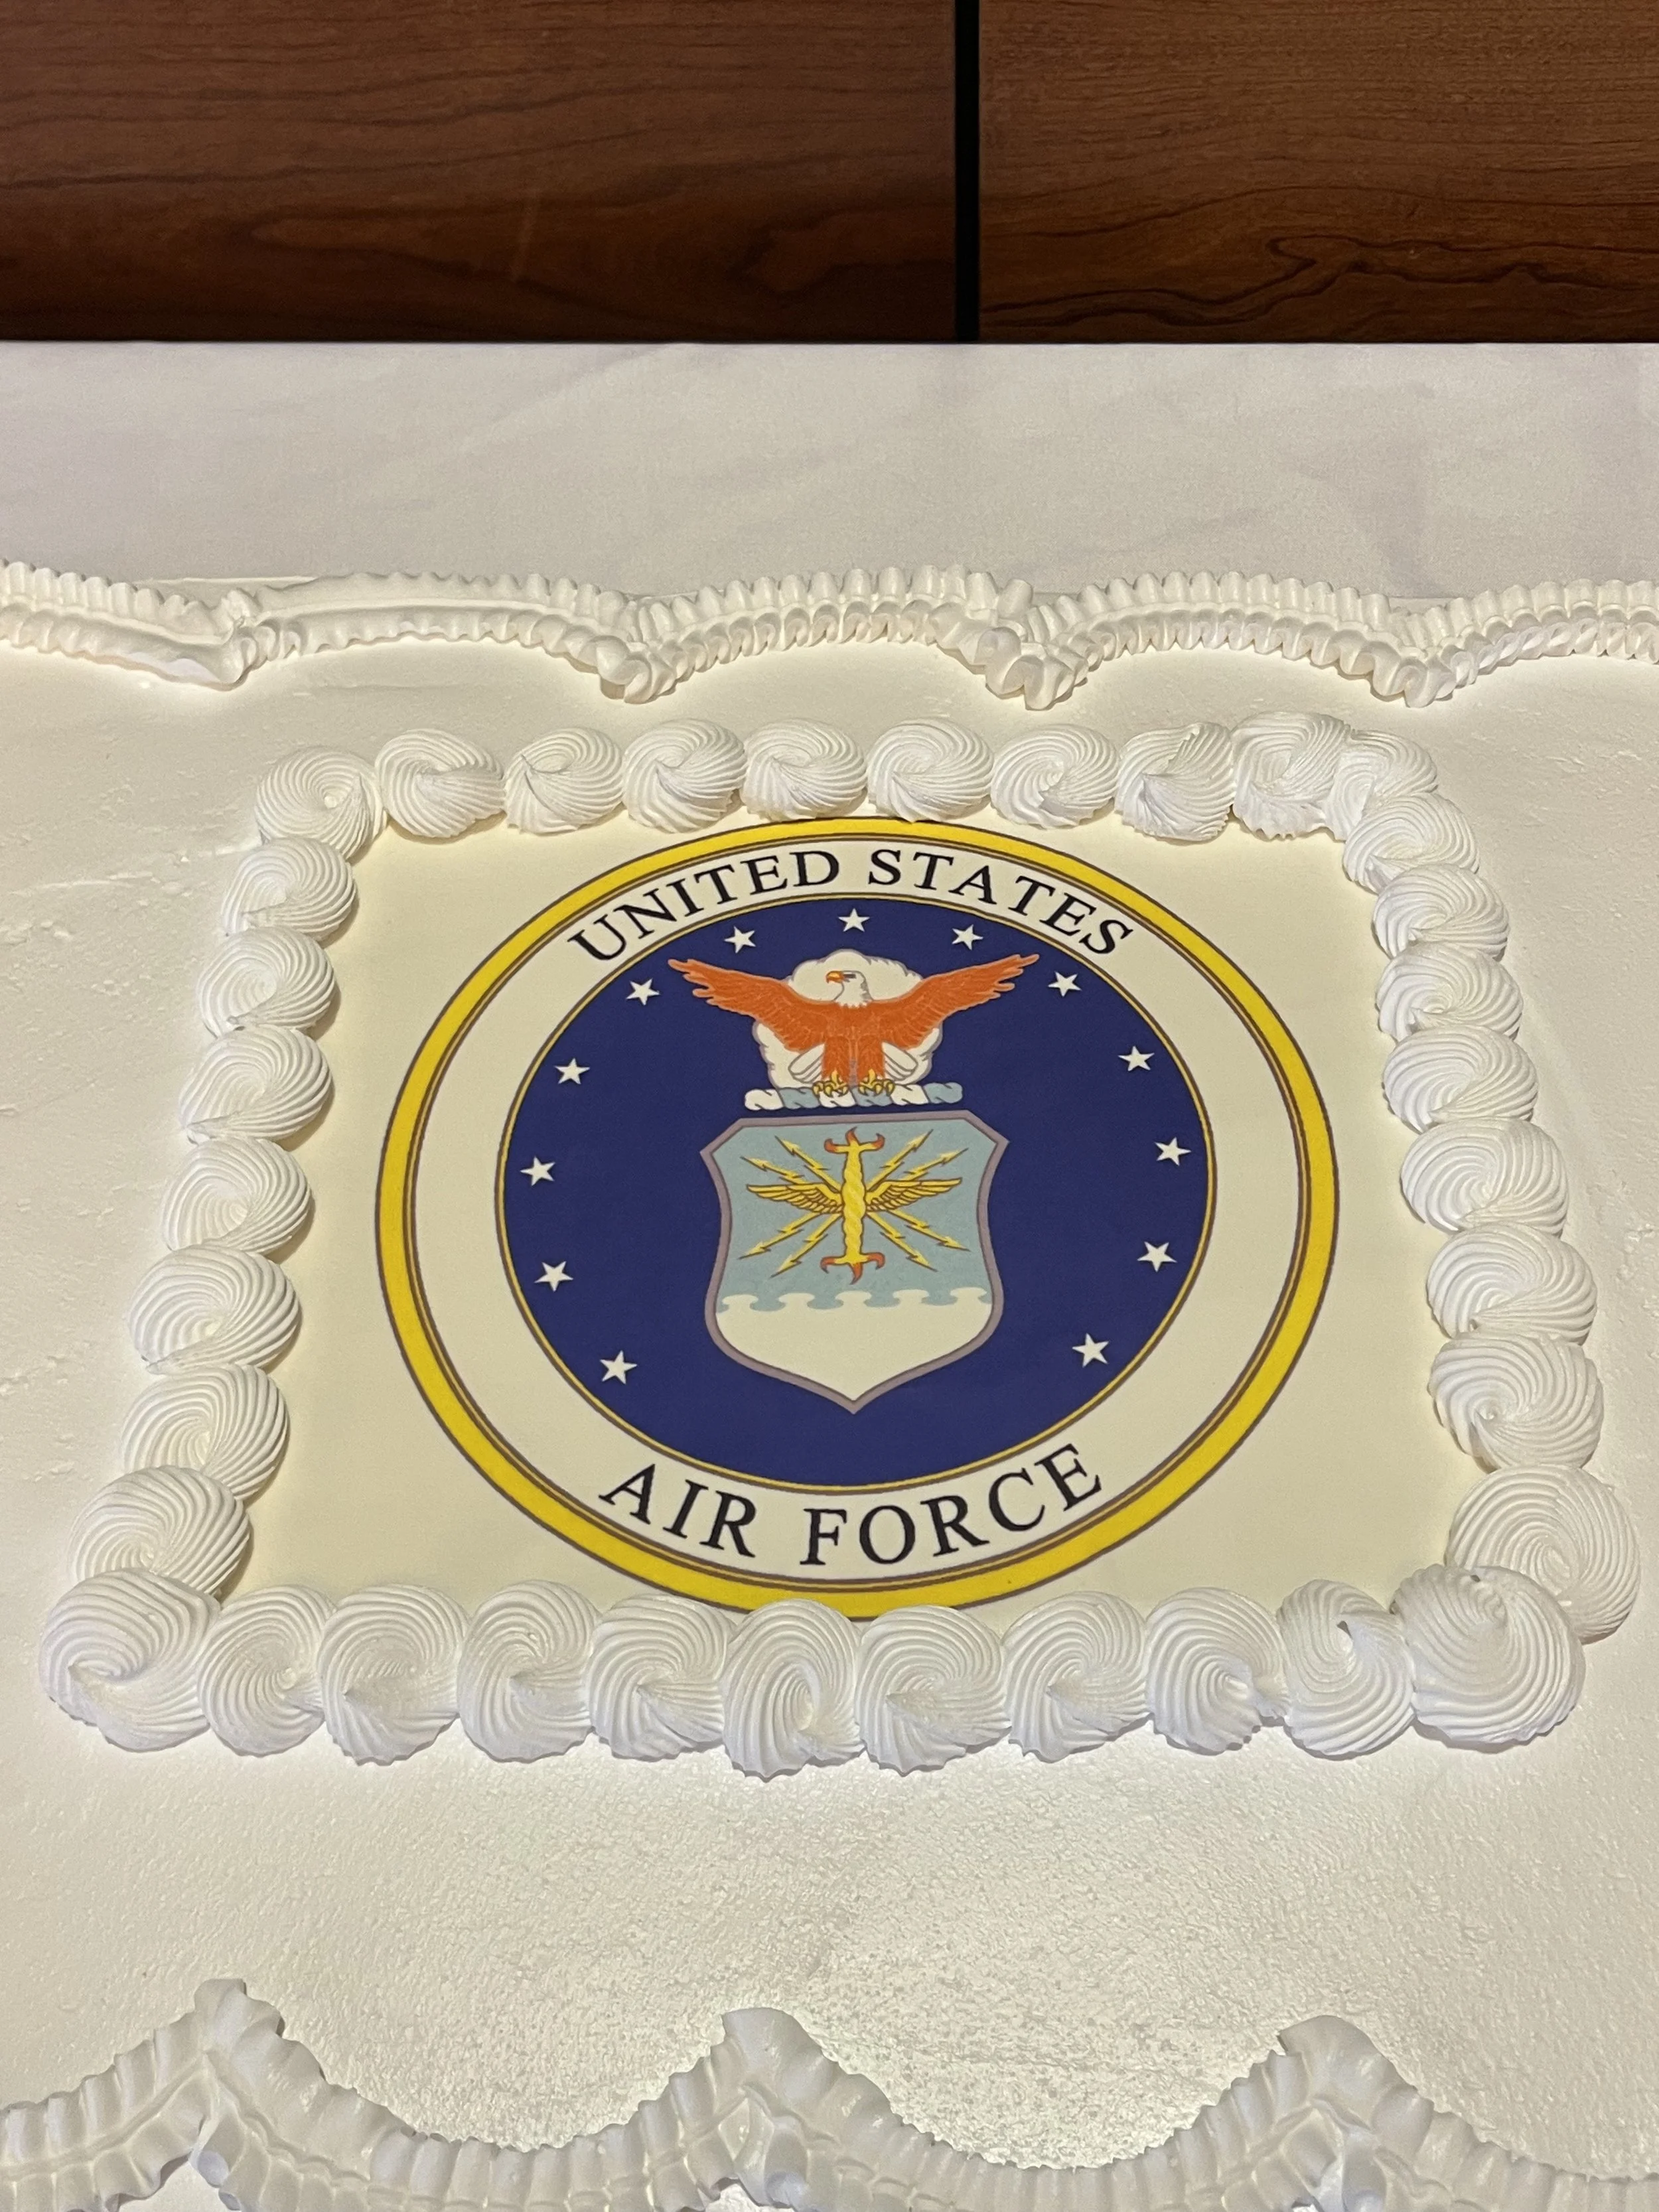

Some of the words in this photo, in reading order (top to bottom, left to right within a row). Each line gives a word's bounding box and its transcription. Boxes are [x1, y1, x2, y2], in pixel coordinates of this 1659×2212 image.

[567, 850, 839, 961] UNITED
[868, 849, 1133, 955] STATES
[598, 1463, 758, 1558] AIR
[799, 1443, 1102, 1566] FORCE
